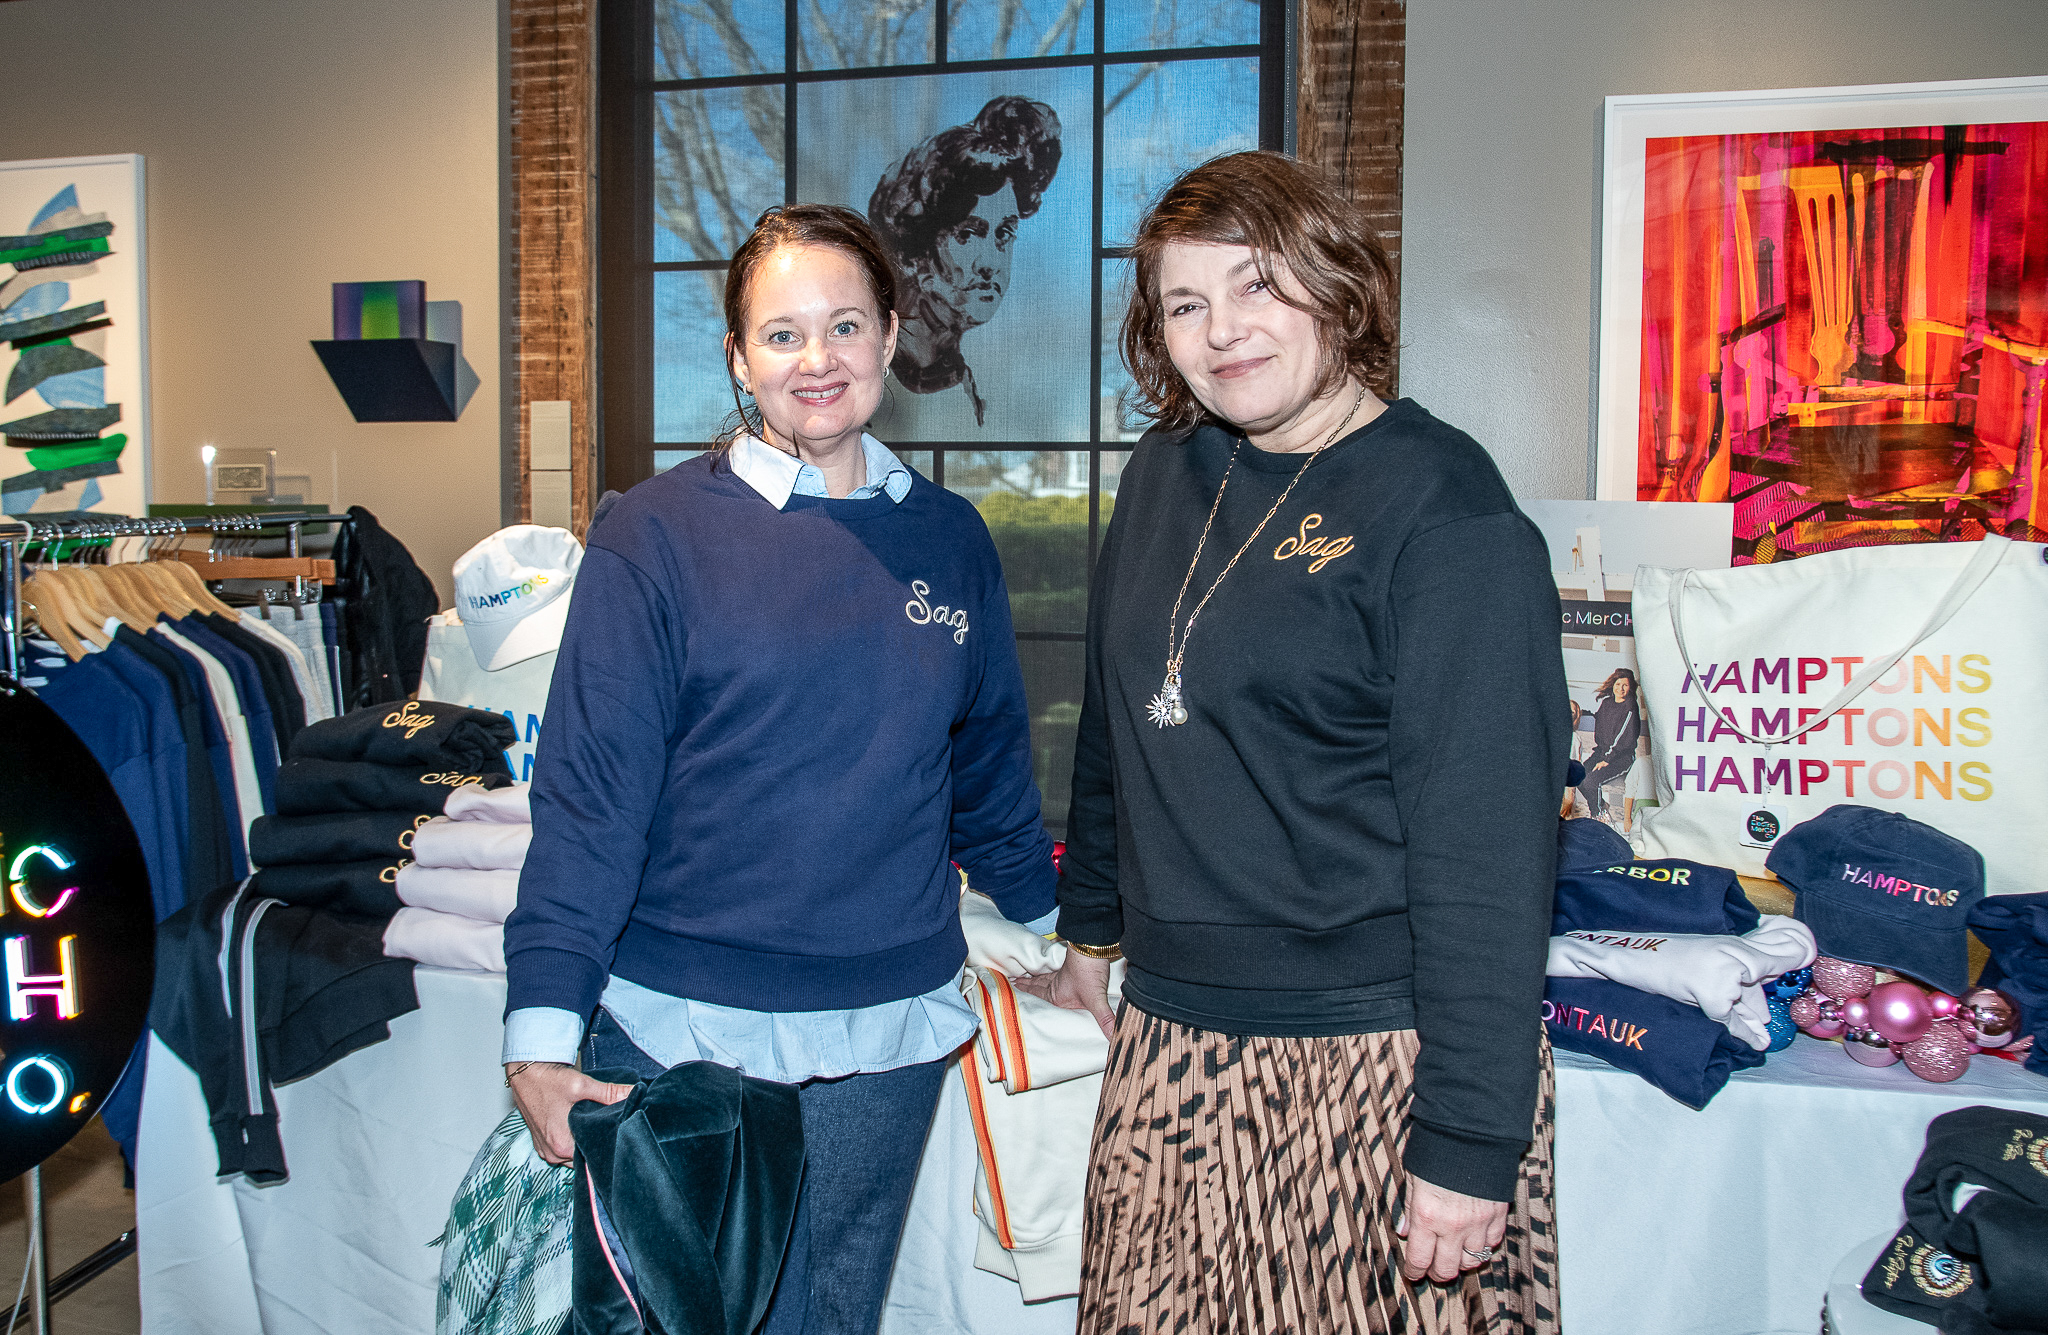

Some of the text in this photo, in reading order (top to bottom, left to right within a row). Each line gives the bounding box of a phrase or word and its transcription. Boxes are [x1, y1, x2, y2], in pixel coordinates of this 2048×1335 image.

[1273, 513, 1355, 574] Sag
[468, 574, 549, 609] HAMPTONS
[905, 580, 969, 645] Sag
[1681, 654, 1993, 695] HAMPTONS
[382, 701, 435, 739] Sag
[1676, 706, 1993, 747] HAMPTONS
[1675, 755, 1994, 802] HAMPTONS
